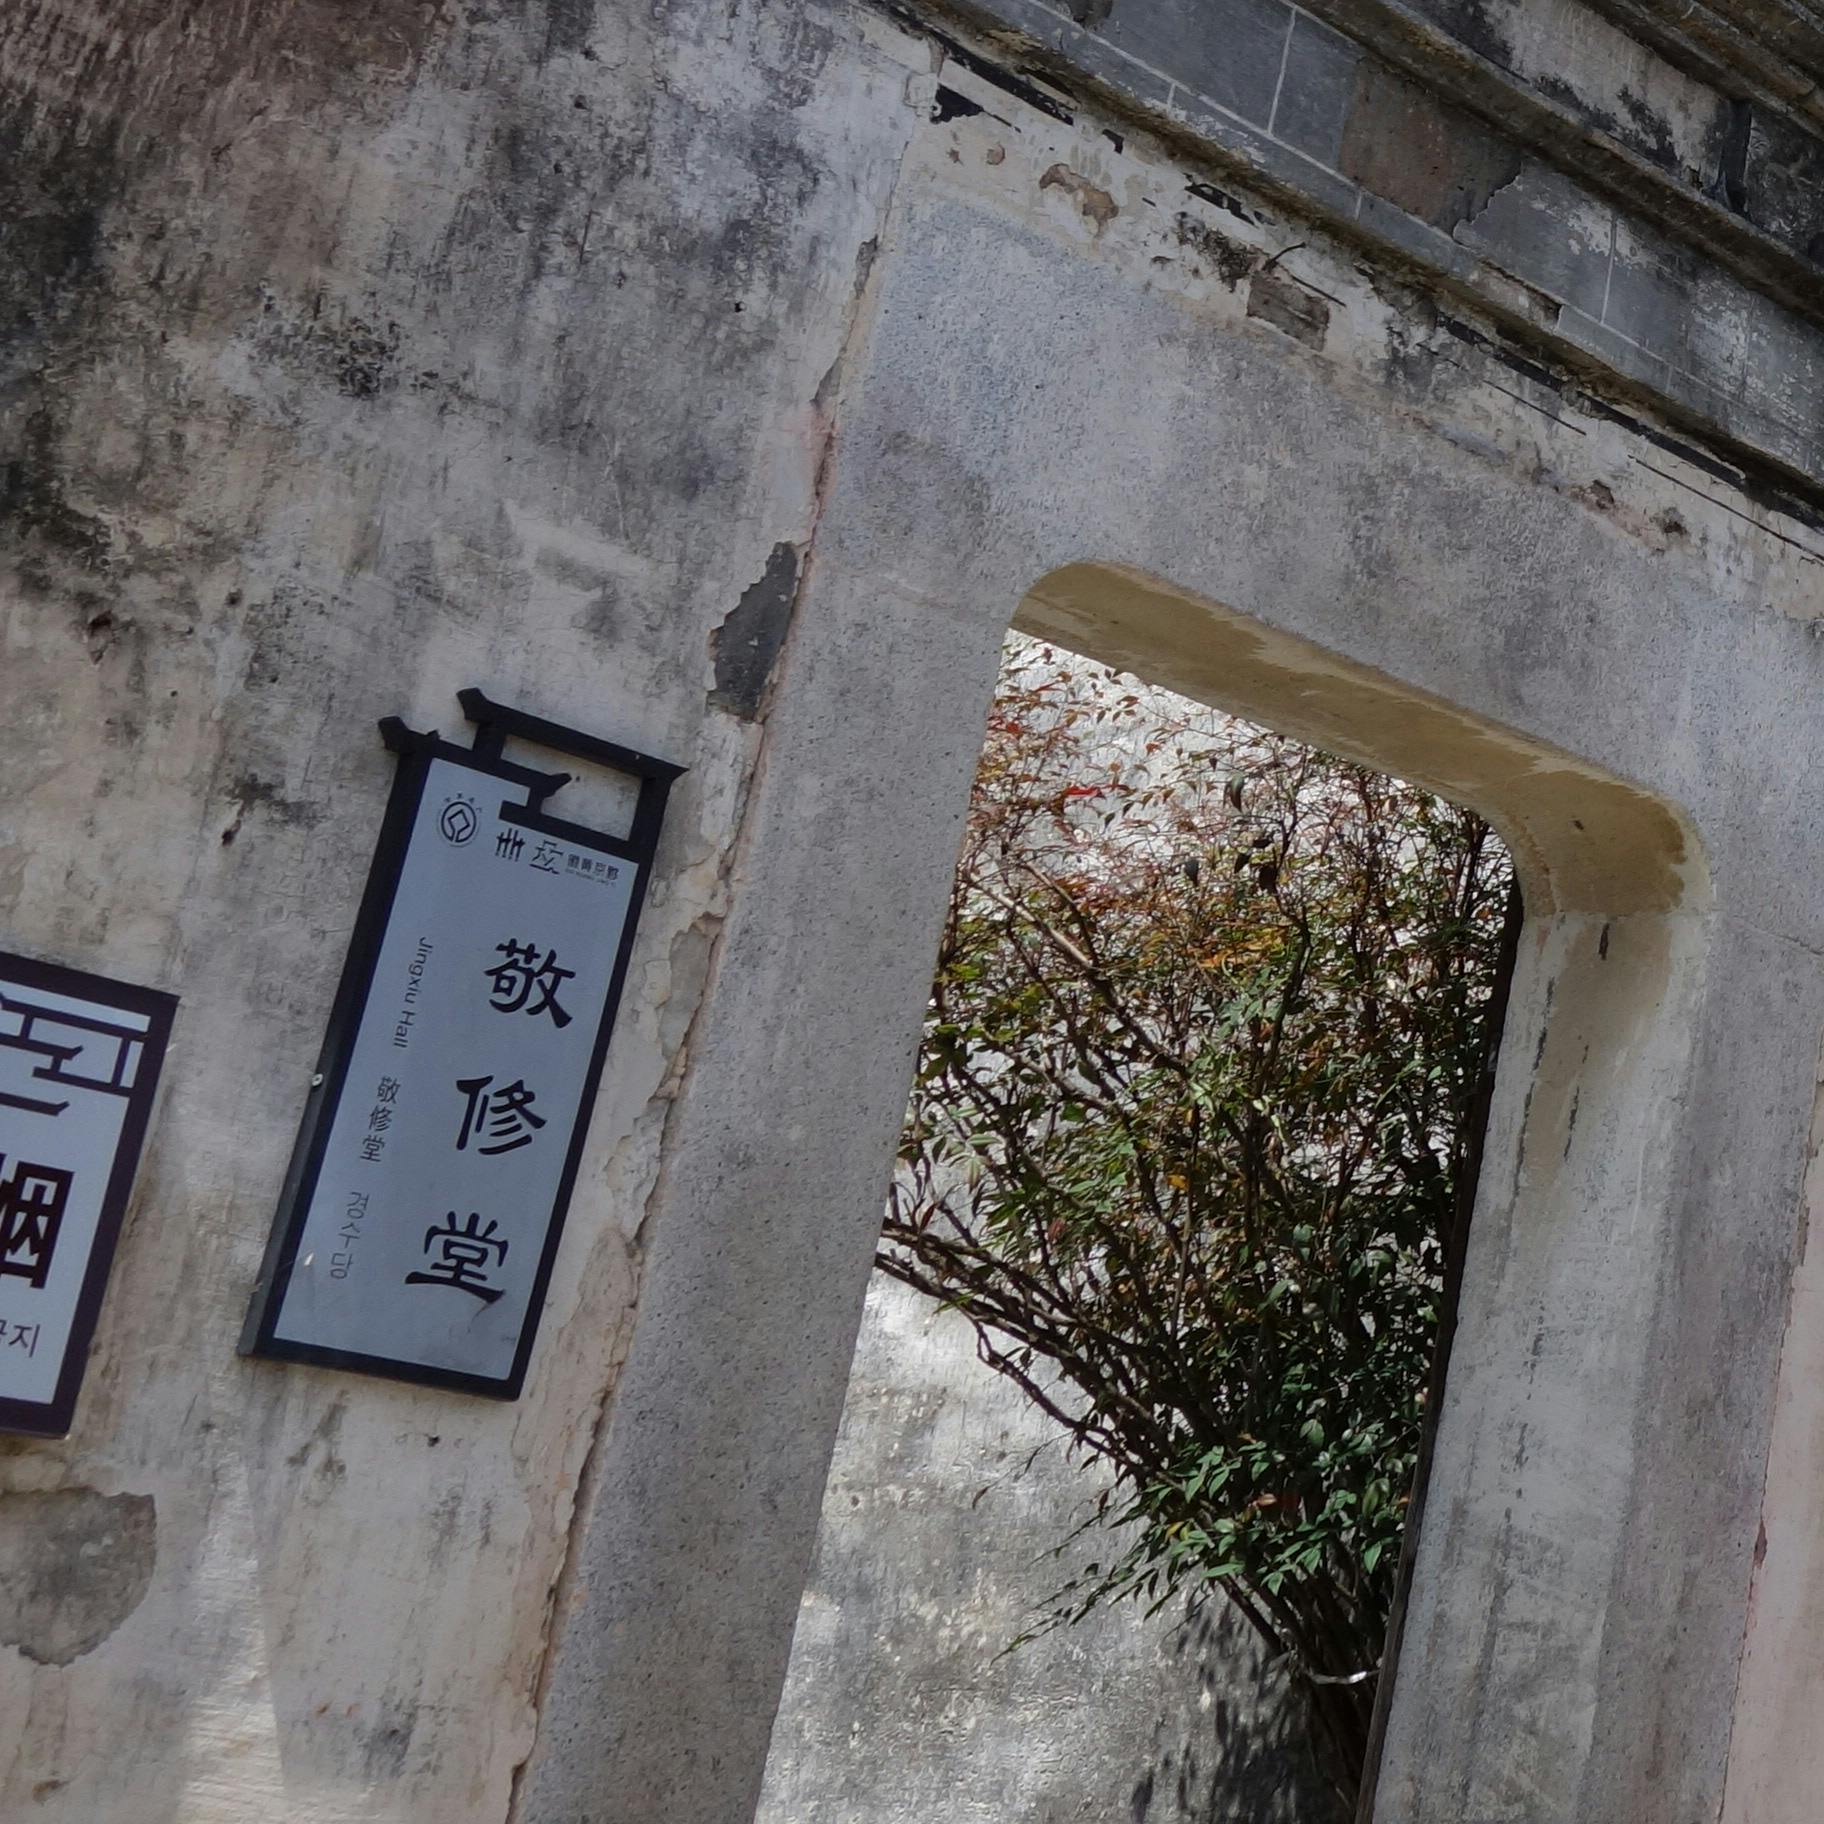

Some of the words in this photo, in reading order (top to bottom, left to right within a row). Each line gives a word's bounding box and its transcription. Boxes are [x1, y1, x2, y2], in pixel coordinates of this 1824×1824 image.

[403, 936, 434, 1004] Jingxiu
[393, 1010, 416, 1048] Hall
[360, 1076, 400, 1162] 敬修堂
[405, 938, 576, 1304] 敬修堂
